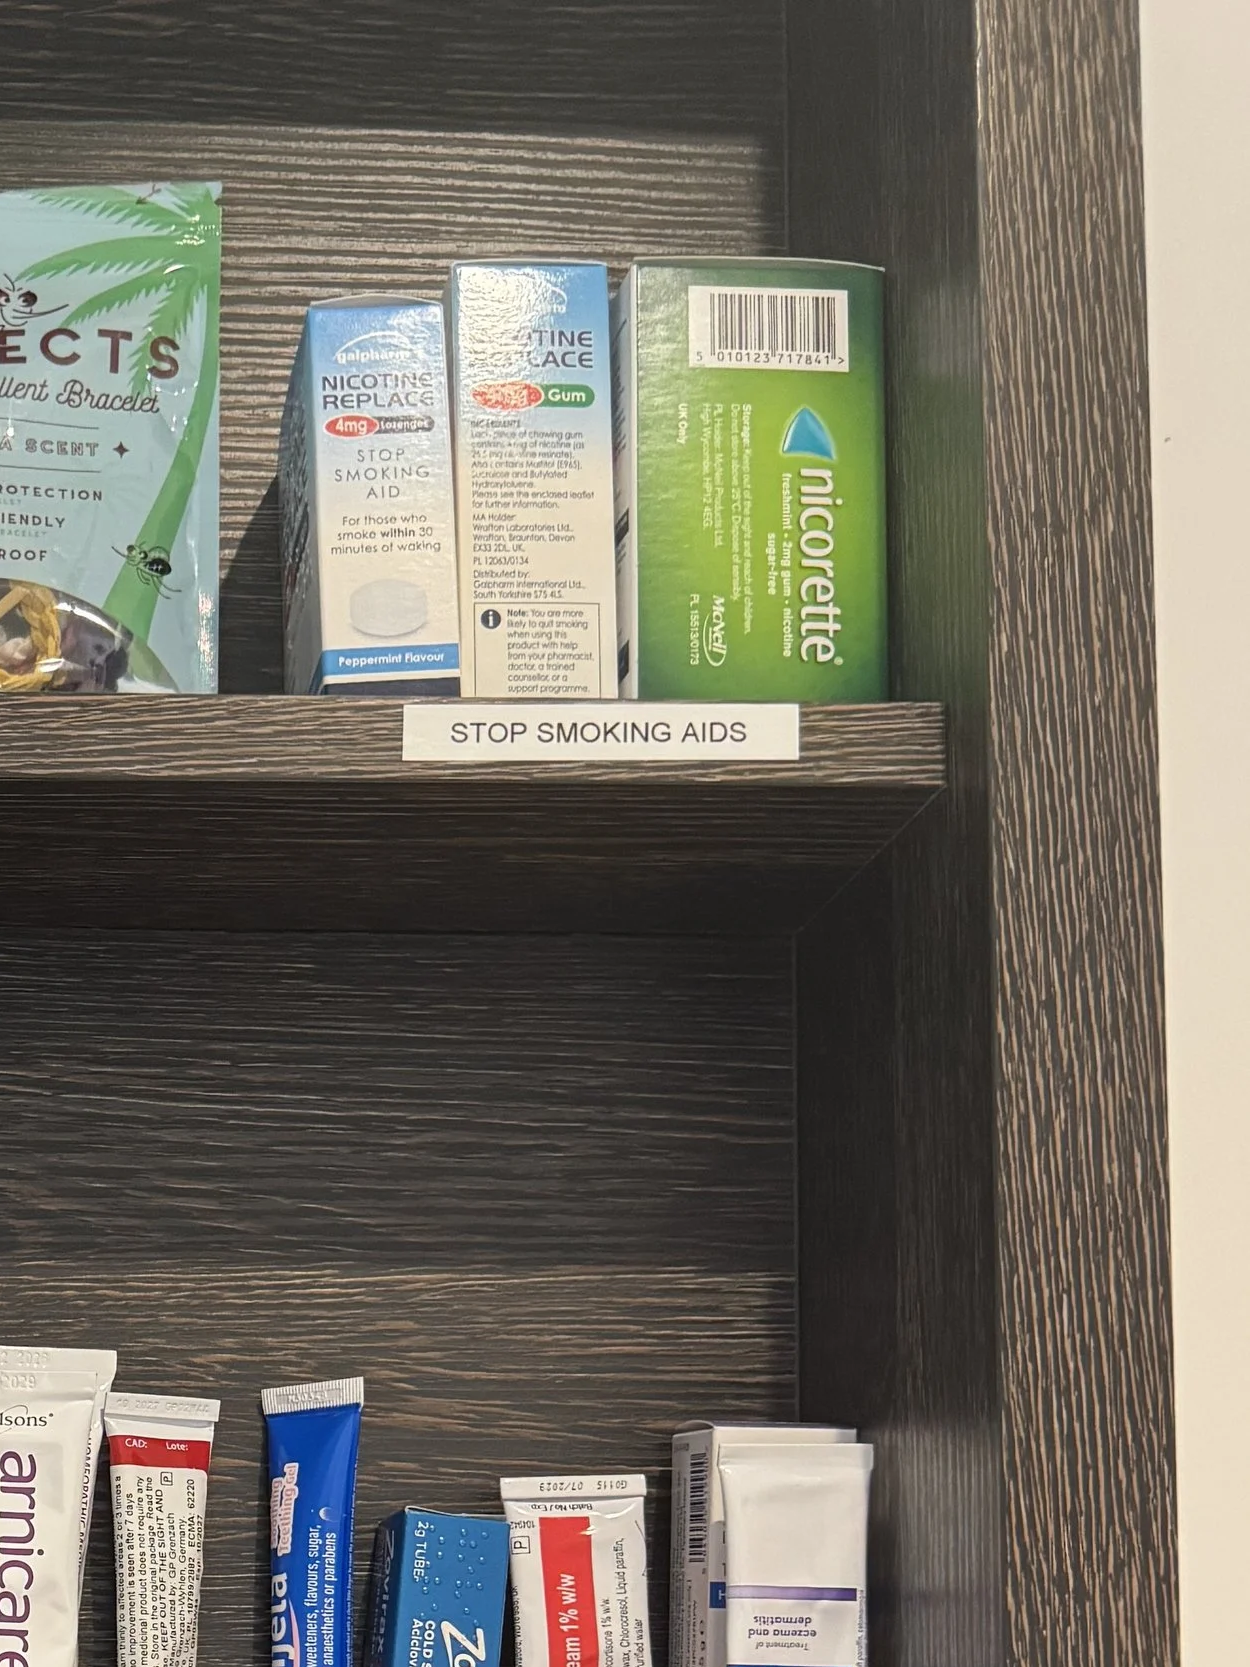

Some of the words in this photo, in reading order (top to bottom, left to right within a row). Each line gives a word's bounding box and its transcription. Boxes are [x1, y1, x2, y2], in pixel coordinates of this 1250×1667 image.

[321, 372, 434, 392] NICOTINE
[55, 379, 161, 414] Bracelet
[322, 390, 434, 411] REPLACE
[547, 388, 586, 403] Gum
[25, 438, 100, 458] SCENT
[357, 448, 405, 463] STOP
[334, 465, 430, 483] SMOKING
[366, 485, 401, 500] AID
[337, 528, 377, 541] smoke
[379, 526, 416, 539] within
[418, 526, 433, 537] 30
[766, 532, 776, 596] sugar-free
[799, 468, 843, 665] nicorette
[338, 655, 402, 669] Peppermint
[404, 651, 445, 665] Flavour
[450, 722, 527, 744] STOP
[537, 722, 672, 744] SMOKING
[681, 721, 748, 743] AIDS
[322, 1532, 338, 1581] parabens
[556, 1573, 577, 1605] w/w
[559, 1608, 580, 1633] 1%
[320, 1598, 336, 1666] anaesthetics
[424, 1620, 437, 1660] COLD
